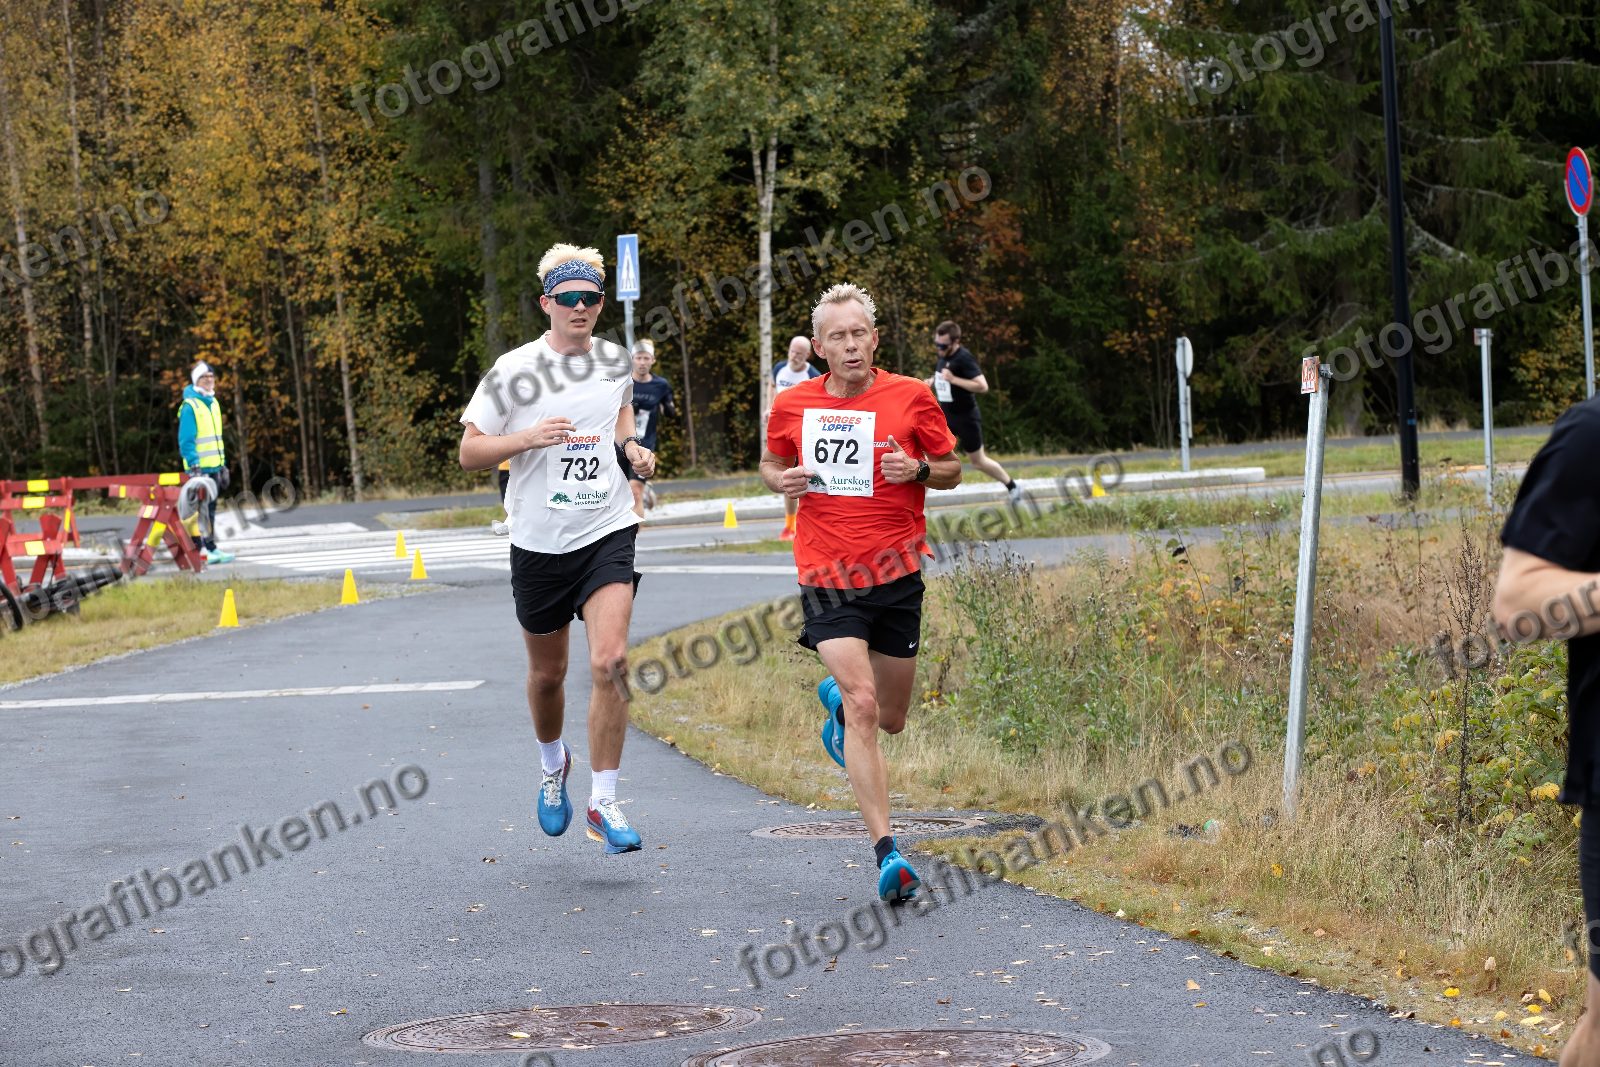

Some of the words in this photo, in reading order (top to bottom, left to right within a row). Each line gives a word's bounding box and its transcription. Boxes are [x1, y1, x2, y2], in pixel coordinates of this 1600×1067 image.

[819, 415, 861, 424] NORGES
[822, 423, 854, 432] LØPET
[562, 435, 600, 444] NORGES
[566, 443, 597, 452] LØPET
[815, 438, 859, 464] 672
[560, 456, 600, 481] 732
[830, 475, 870, 489] Aurskog
[575, 490, 608, 500] Aurskog
